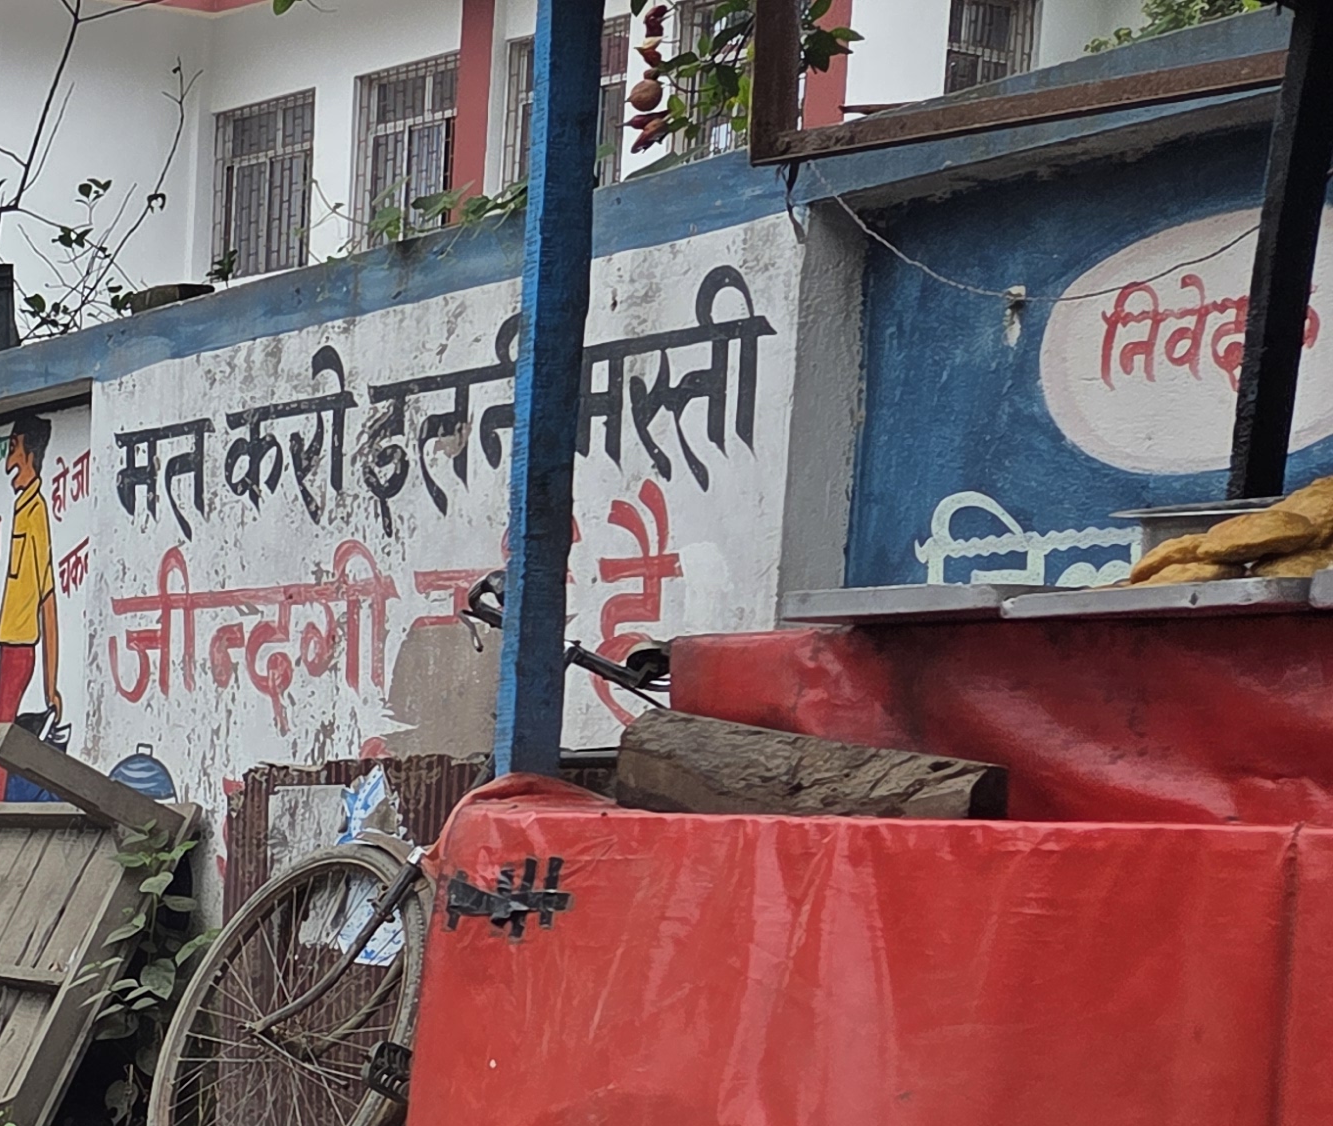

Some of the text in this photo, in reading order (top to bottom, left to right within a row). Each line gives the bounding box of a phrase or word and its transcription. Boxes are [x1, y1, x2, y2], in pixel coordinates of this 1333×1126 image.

[52, 456, 70, 522] हो
[115, 417, 215, 541] मत
[224, 345, 356, 524] करो
